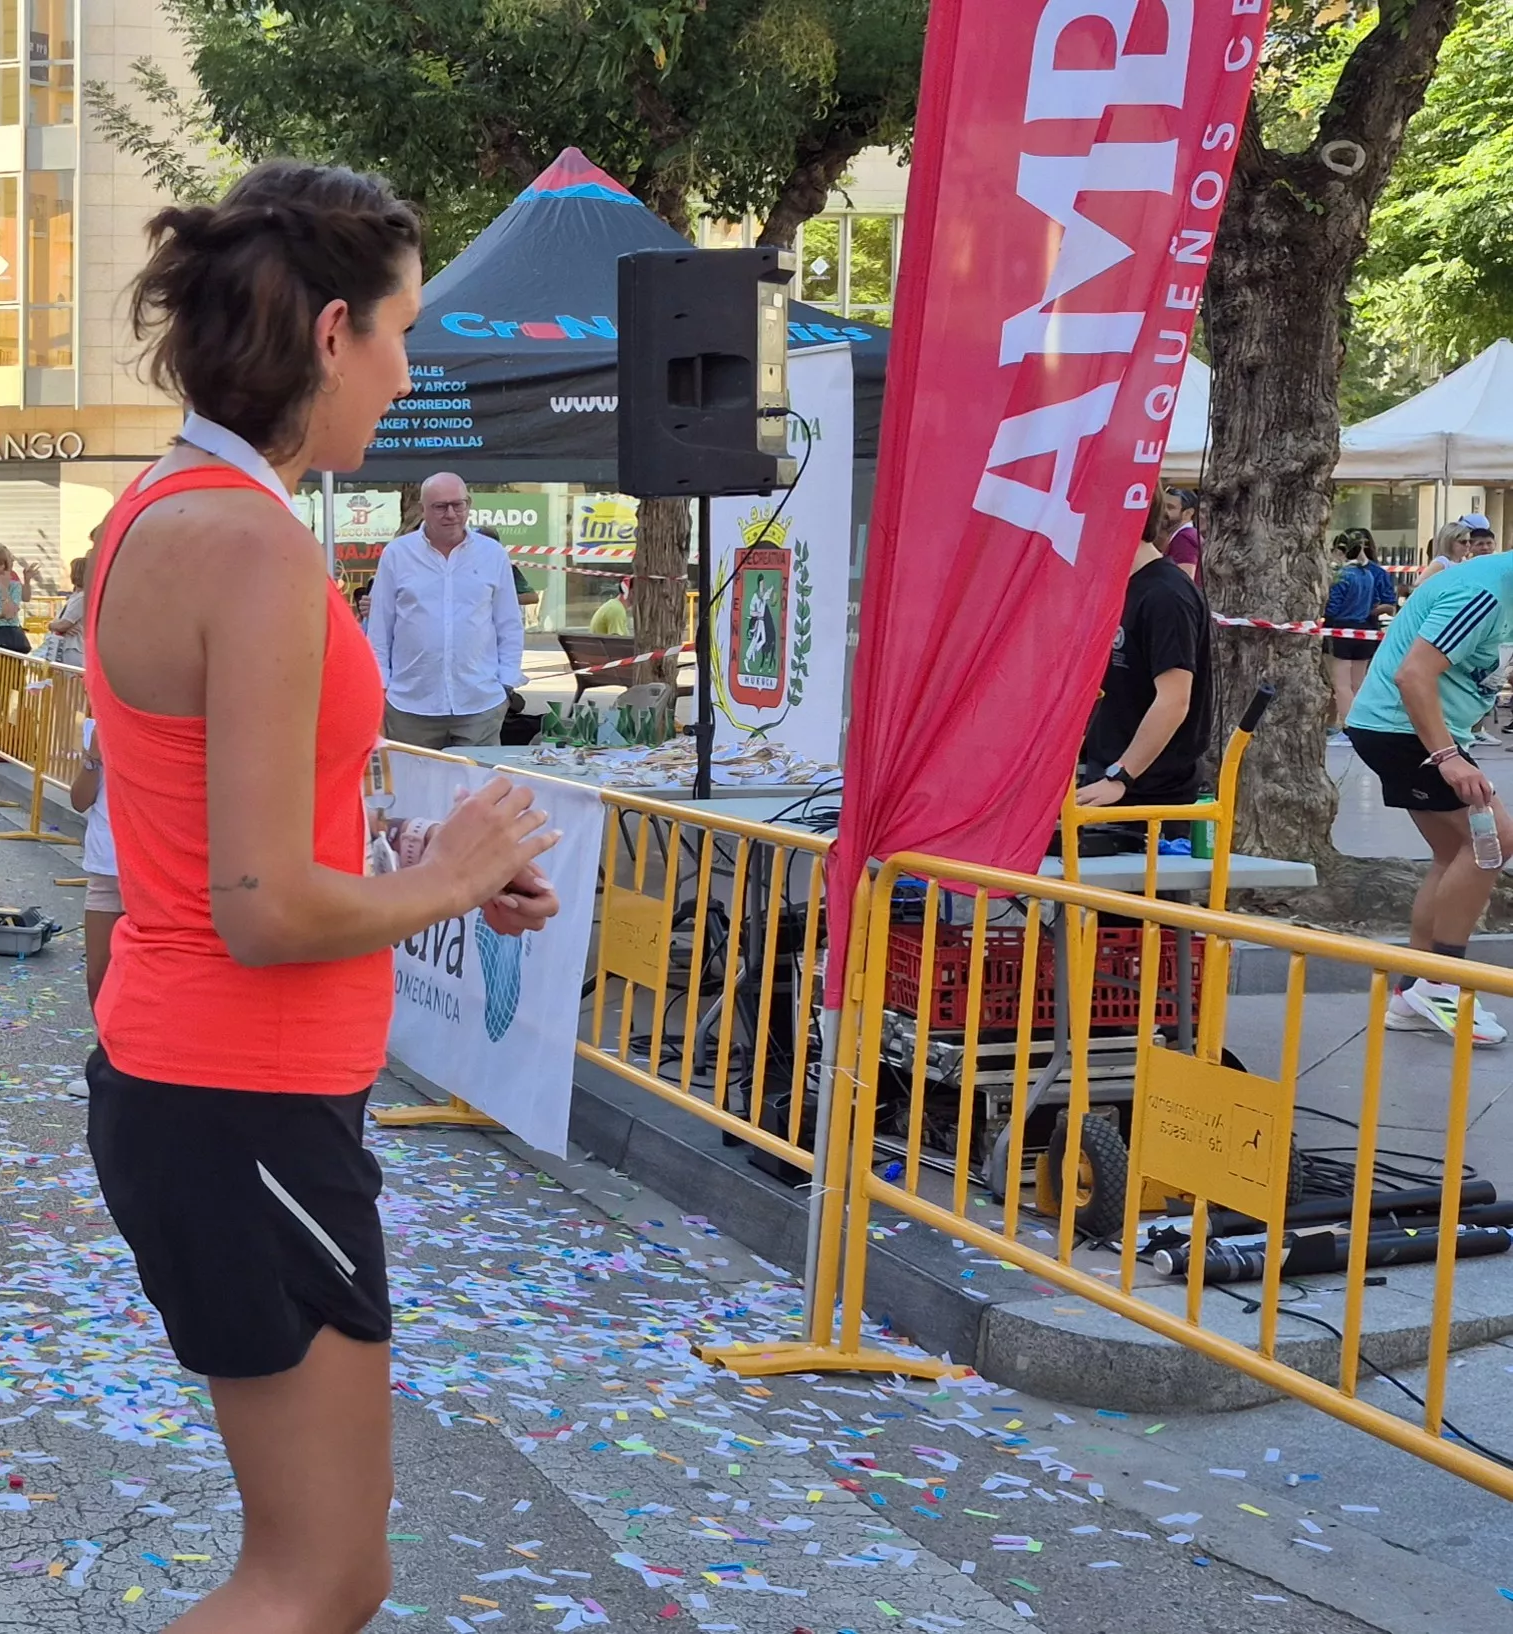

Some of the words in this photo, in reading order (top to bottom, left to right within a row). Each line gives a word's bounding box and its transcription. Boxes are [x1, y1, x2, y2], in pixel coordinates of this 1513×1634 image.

[1123, 122, 1236, 510] PEQUEÑOS
[408, 365, 444, 377] SALES
[424, 381, 466, 392] ARCOS
[398, 399, 471, 410] CORREDOR
[374, 418, 408, 430] AKER
[411, 418, 420, 429] Y
[423, 418, 473, 429] SONIDO
[402, 437, 412, 448] Y
[414, 436, 484, 448] MEDALLAS
